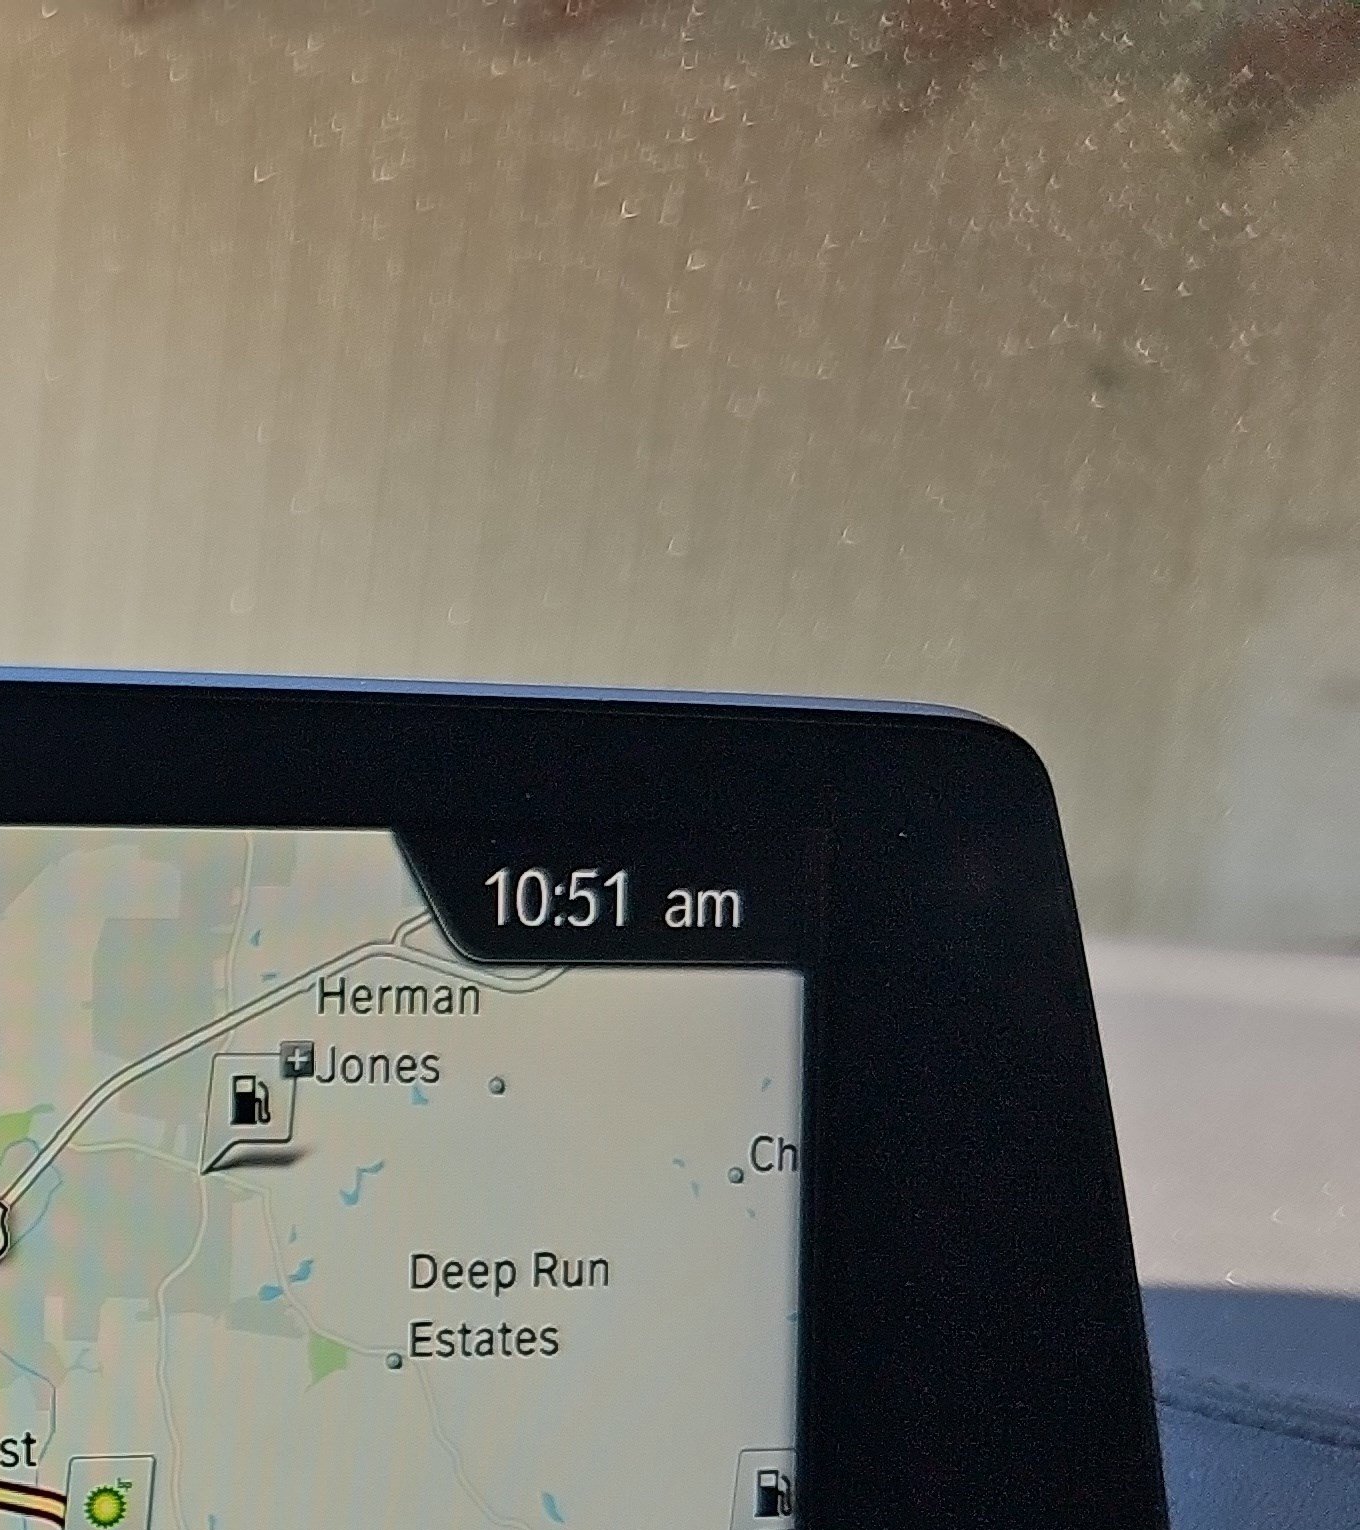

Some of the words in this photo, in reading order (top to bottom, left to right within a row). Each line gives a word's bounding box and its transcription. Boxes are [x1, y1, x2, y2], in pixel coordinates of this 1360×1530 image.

[484, 867, 631, 928] 10:51
[665, 885, 744, 928] am
[316, 976, 482, 1015] Herman
[316, 1046, 441, 1085] Jones
[750, 1135, 798, 1172] Ch
[409, 1253, 517, 1298] Deep
[532, 1251, 611, 1289] Run
[408, 1320, 561, 1359] Estates
